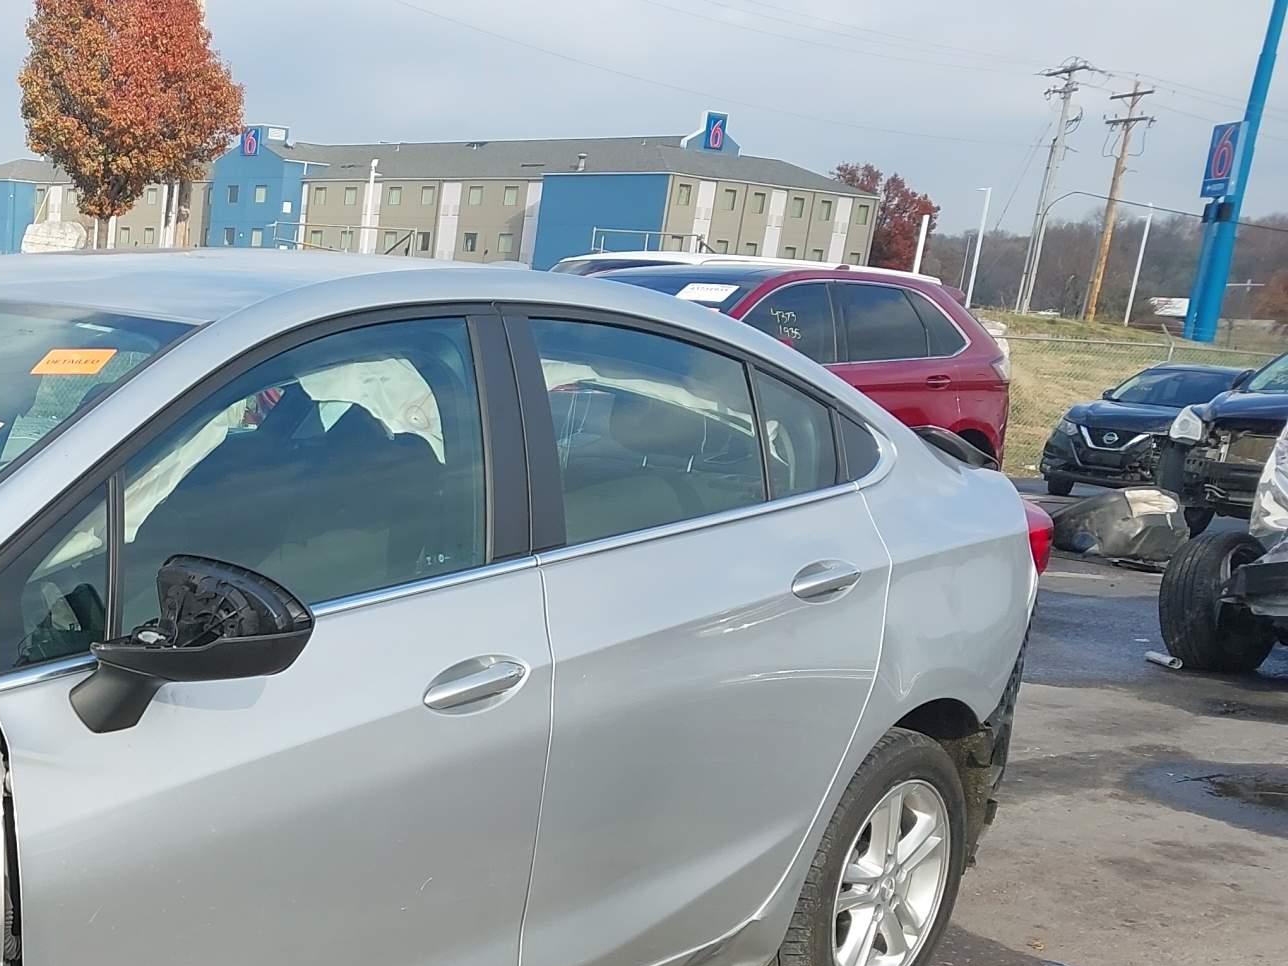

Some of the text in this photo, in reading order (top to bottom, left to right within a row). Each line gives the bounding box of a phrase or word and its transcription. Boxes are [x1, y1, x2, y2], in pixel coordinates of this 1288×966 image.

[244, 128, 257, 154] 6
[710, 119, 723, 148] 6
[1211, 124, 1235, 180] 6
